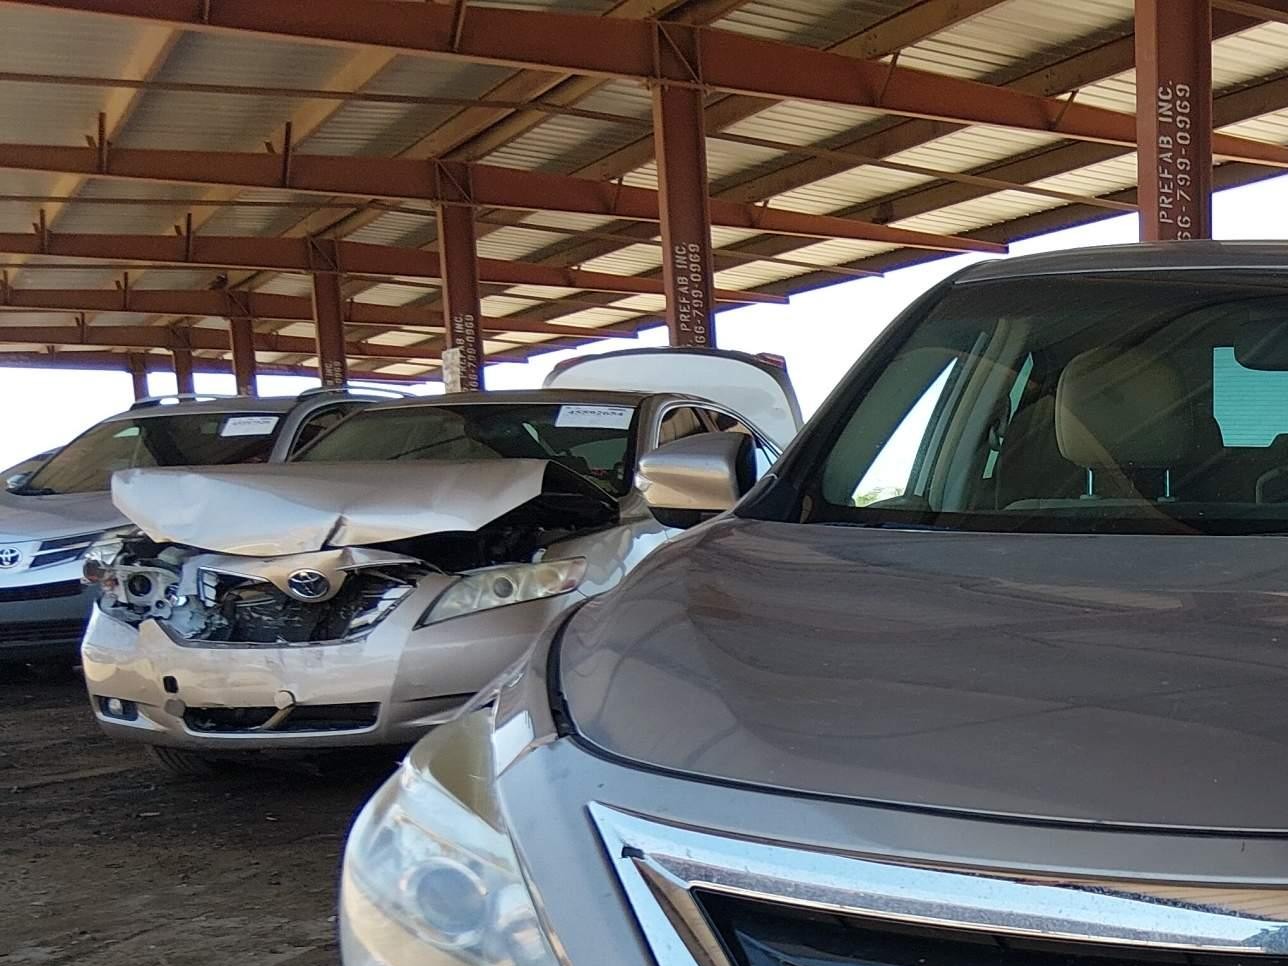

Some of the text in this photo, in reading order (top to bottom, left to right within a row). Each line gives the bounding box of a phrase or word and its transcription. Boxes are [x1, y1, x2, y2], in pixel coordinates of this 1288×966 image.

[1159, 136, 1174, 223] PREFAB
[677, 276, 691, 331] PREFAB
[688, 244, 706, 347] 66-799-0969
